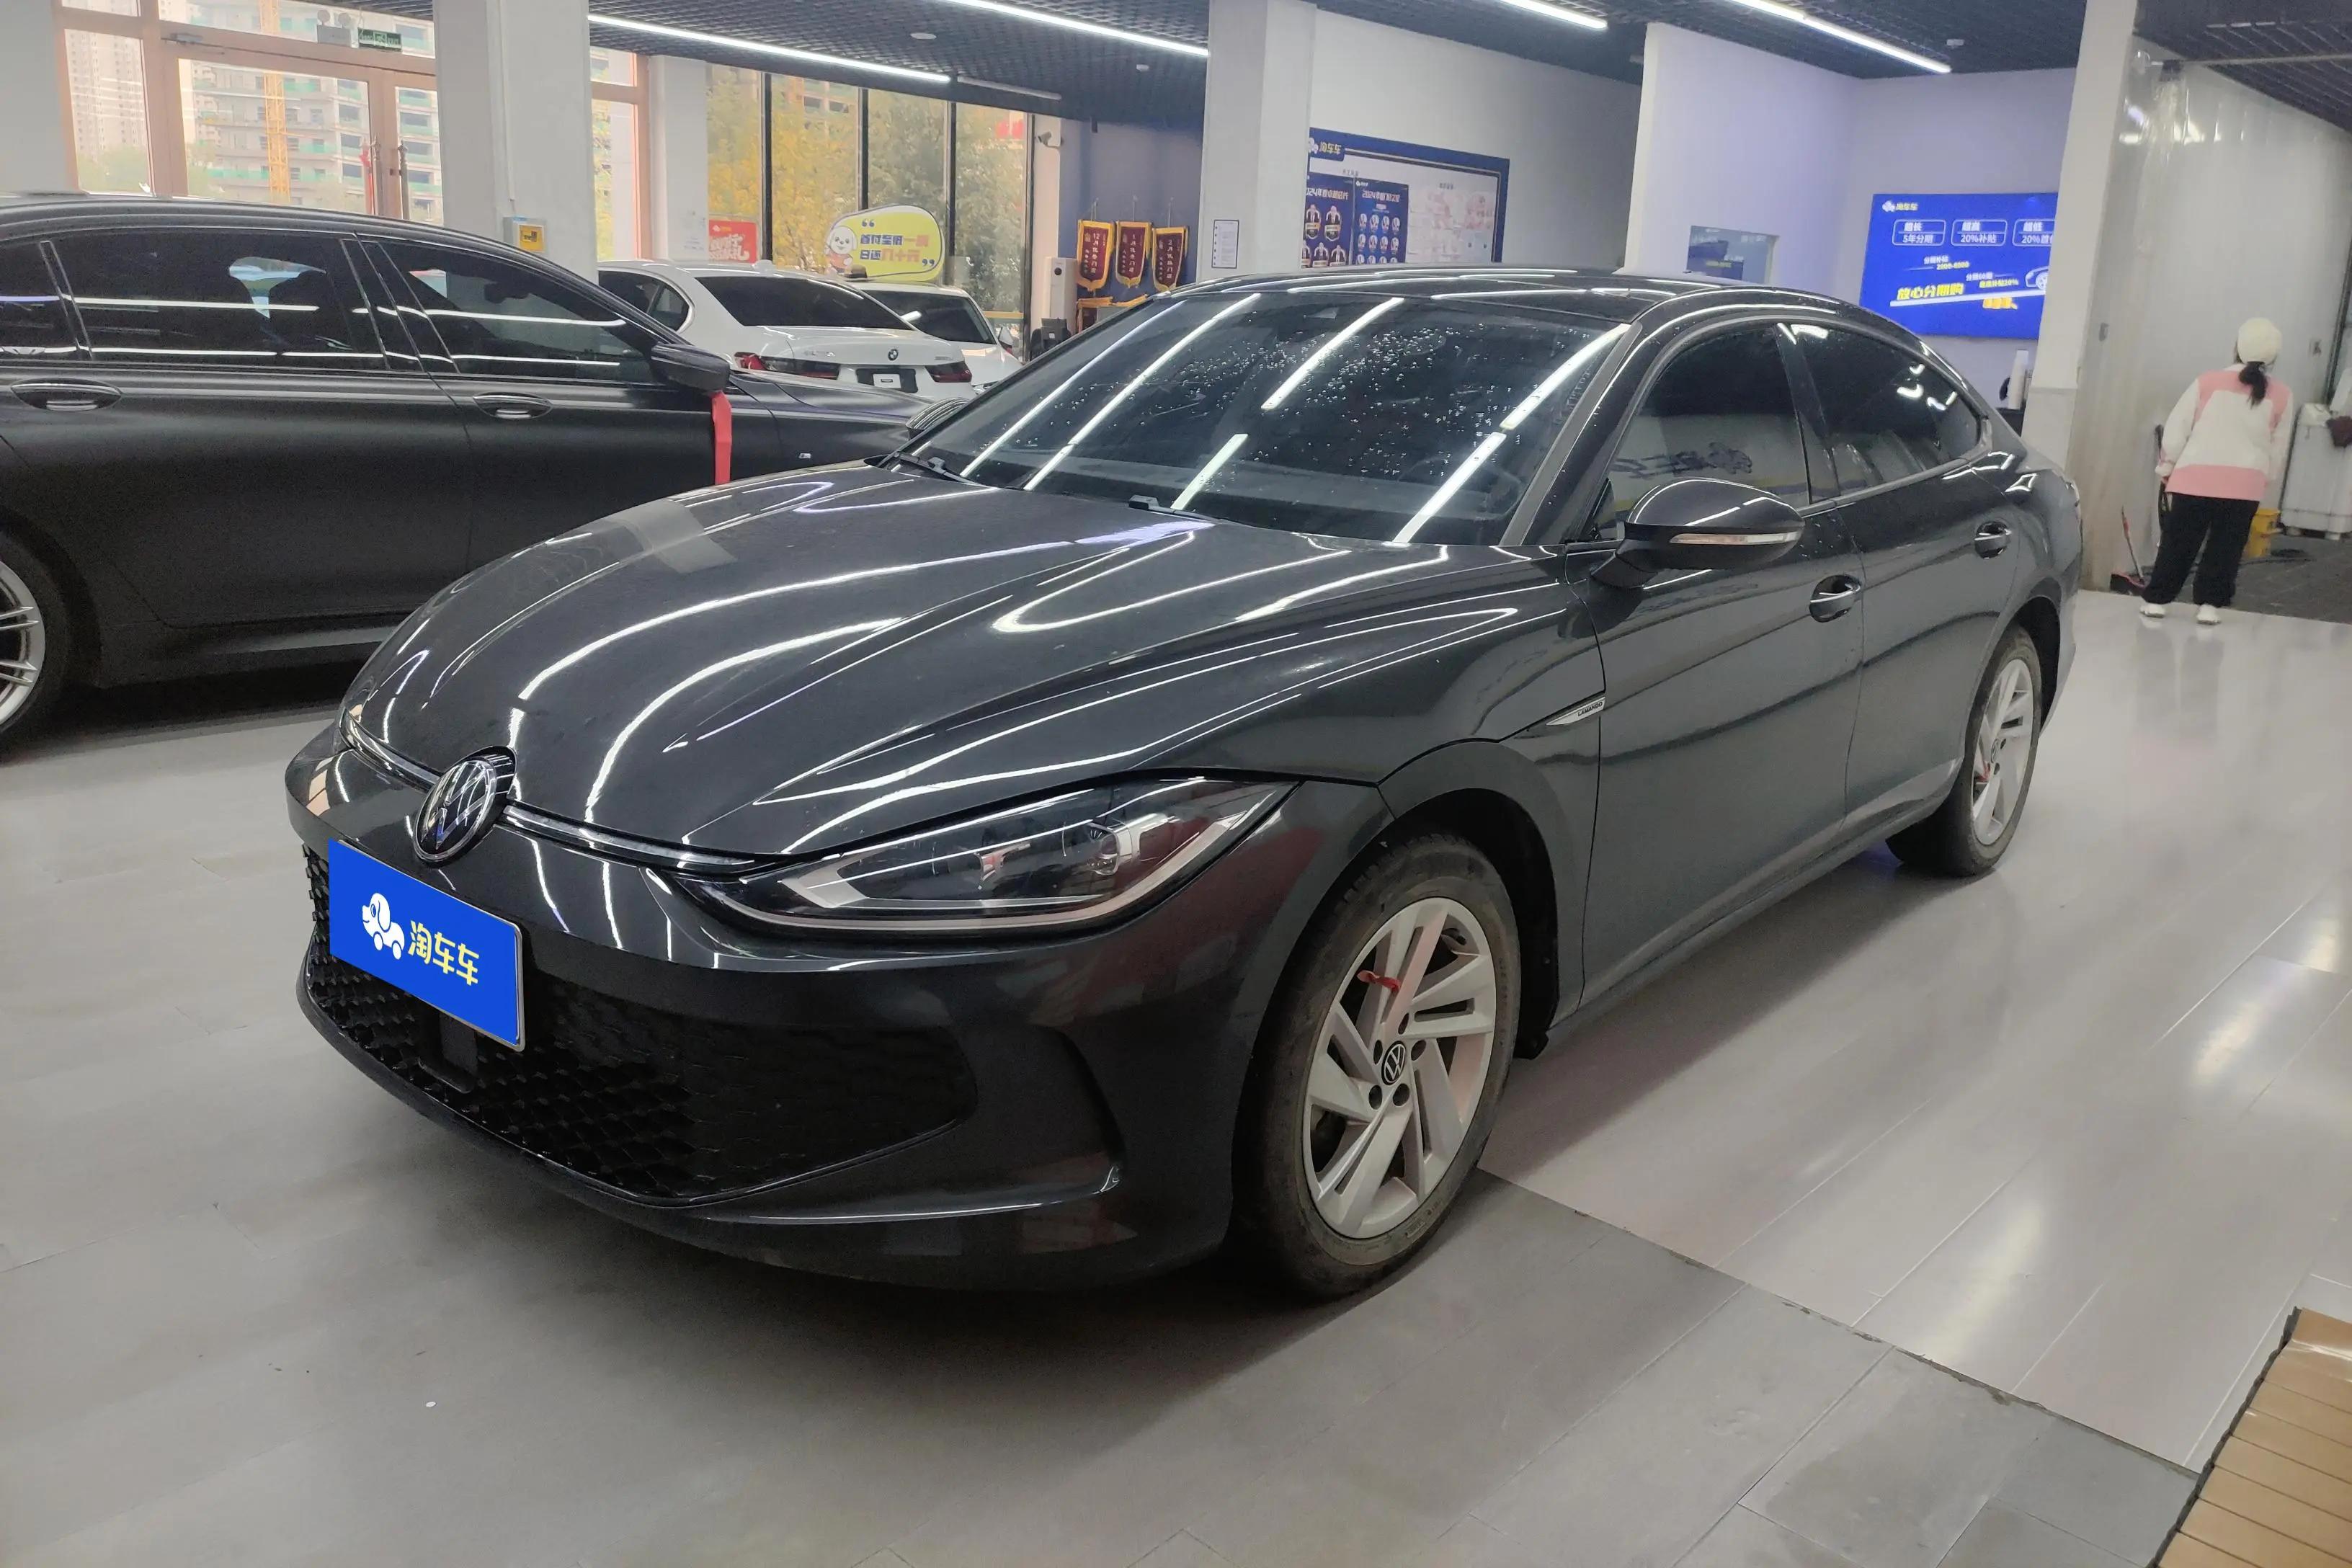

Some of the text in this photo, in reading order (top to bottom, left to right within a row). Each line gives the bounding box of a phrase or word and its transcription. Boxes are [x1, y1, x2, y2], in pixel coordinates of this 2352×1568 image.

[1902, 234, 1933, 244] 5年分期
[1961, 234, 1997, 244] 20%补贴
[1578, 702, 1603, 716] LAMANDO
